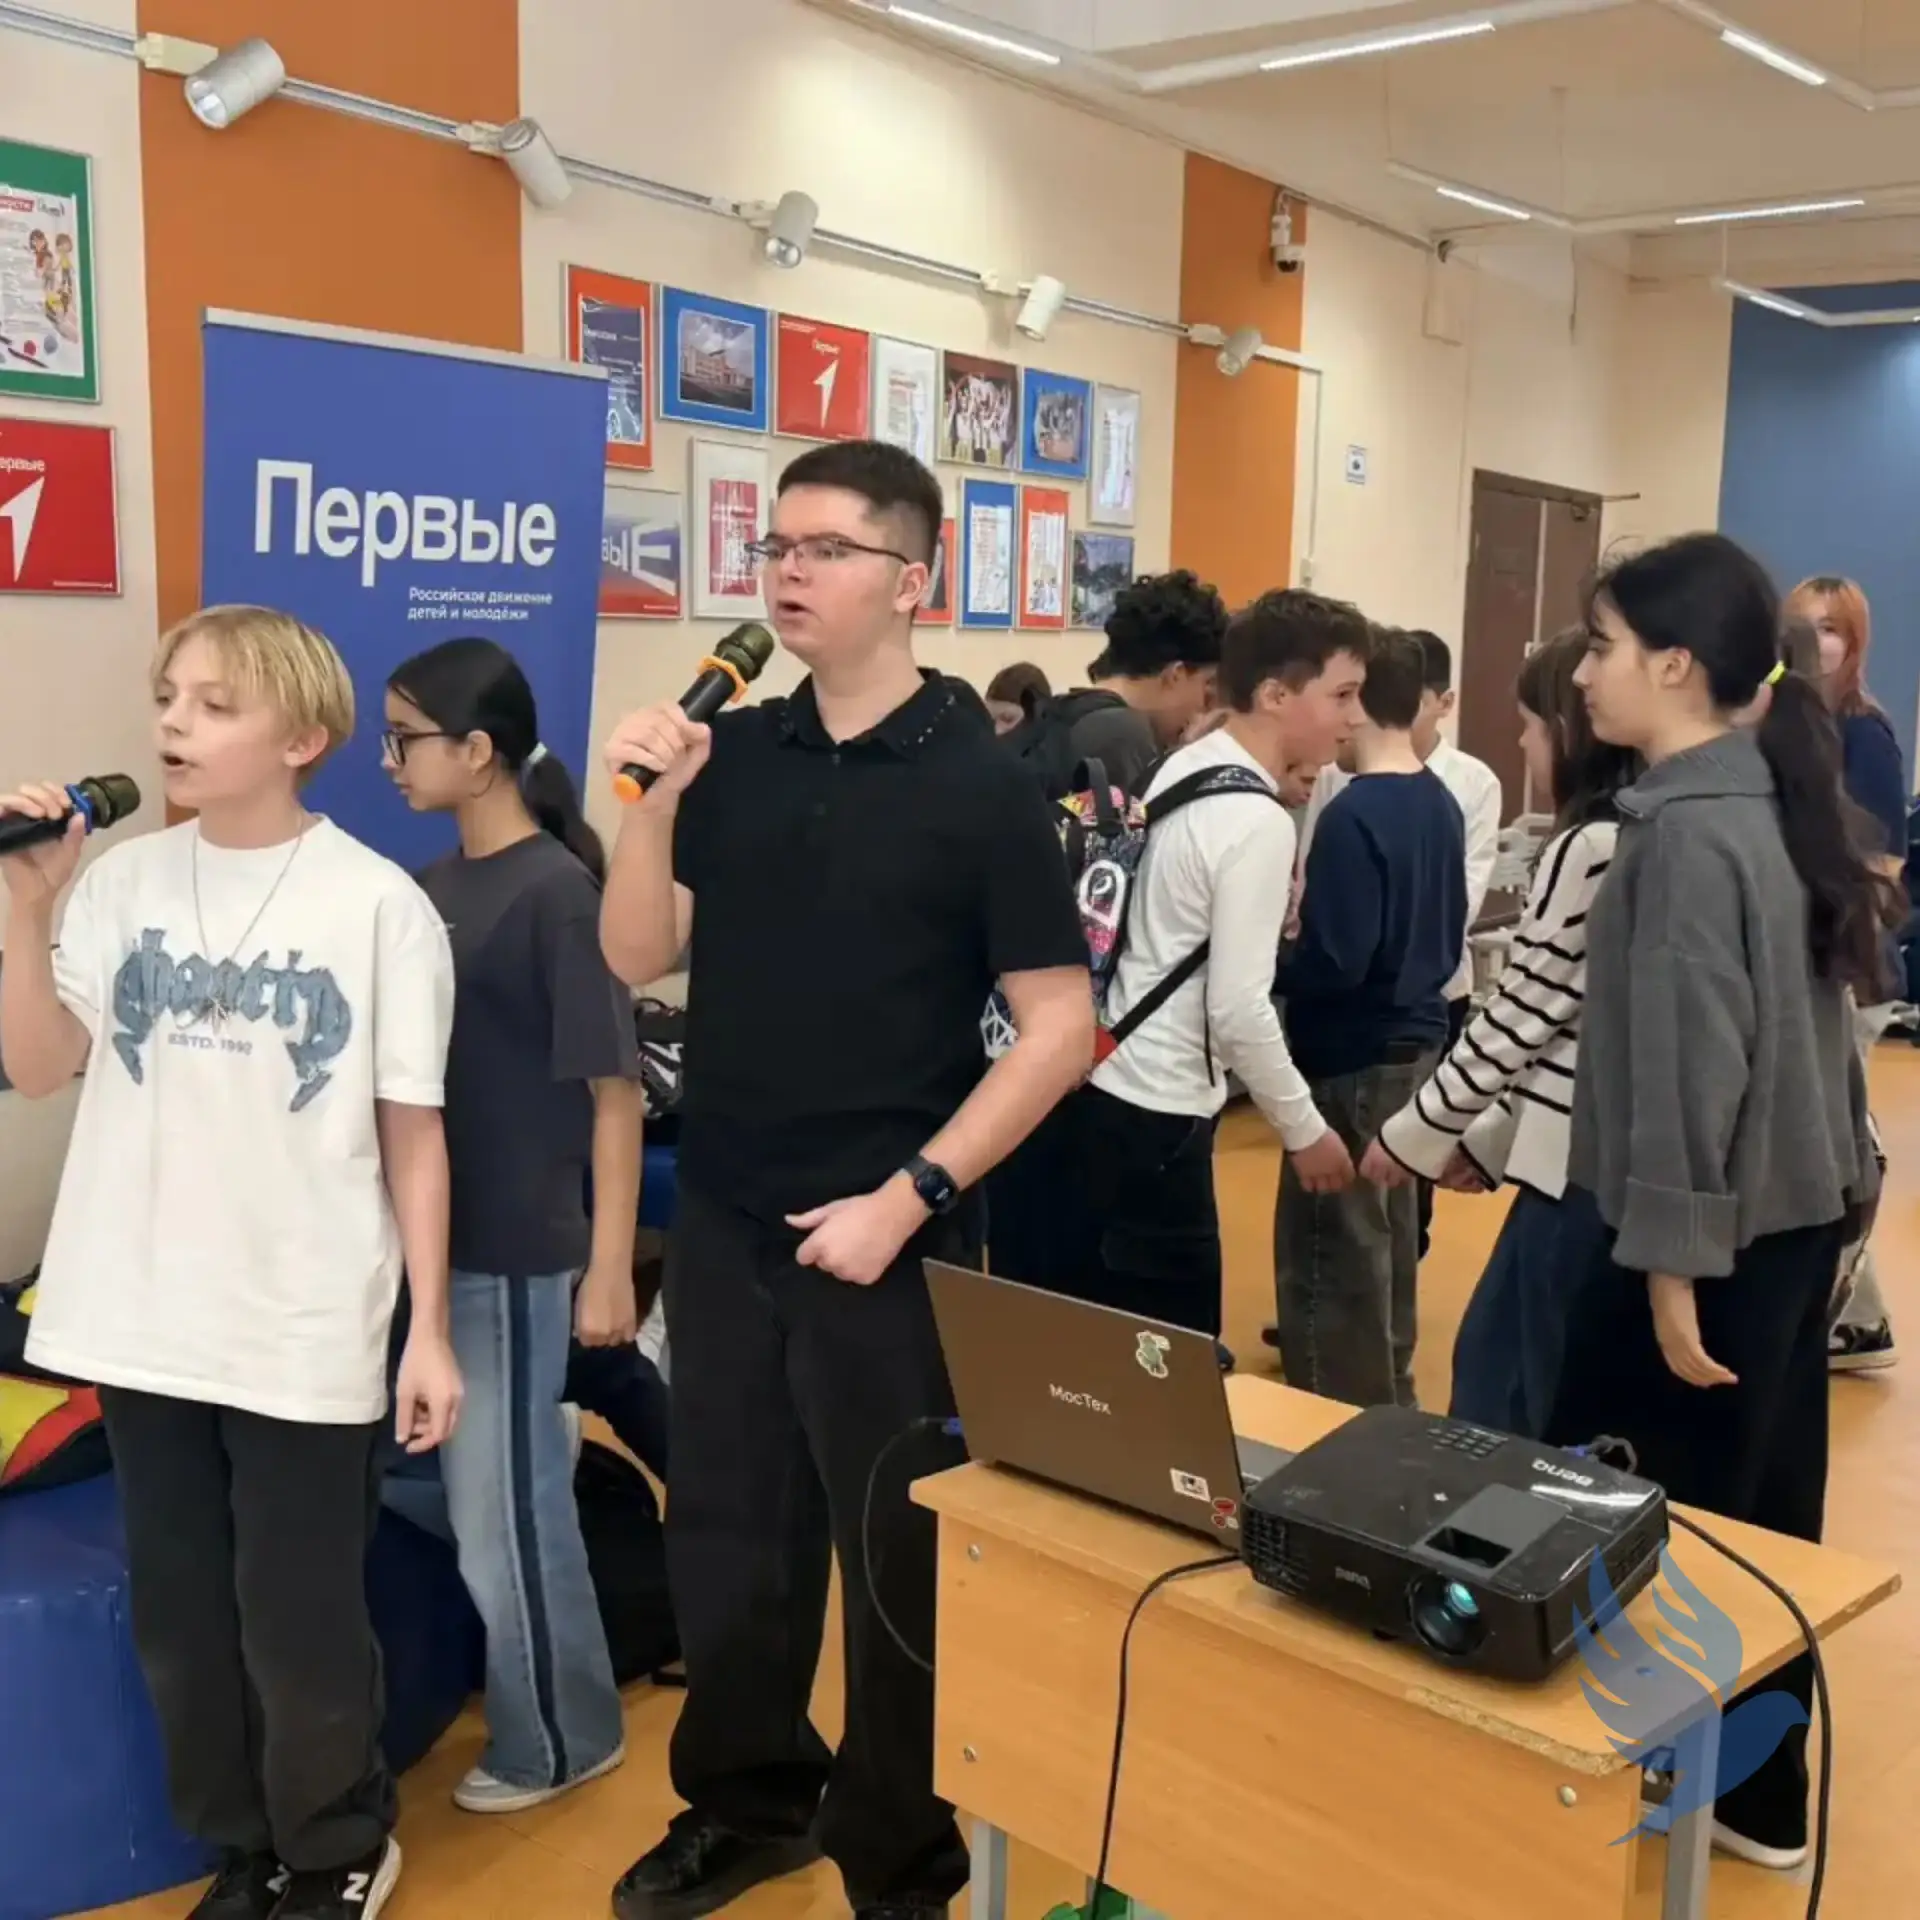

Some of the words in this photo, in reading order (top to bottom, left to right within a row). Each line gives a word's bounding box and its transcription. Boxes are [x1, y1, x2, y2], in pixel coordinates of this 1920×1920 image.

[254, 458, 557, 587] Первые
[409, 586, 486, 603] Российское
[487, 590, 554, 605] движение
[407, 604, 448, 620] детей
[450, 608, 460, 619] и
[462, 606, 530, 621] молодёжи
